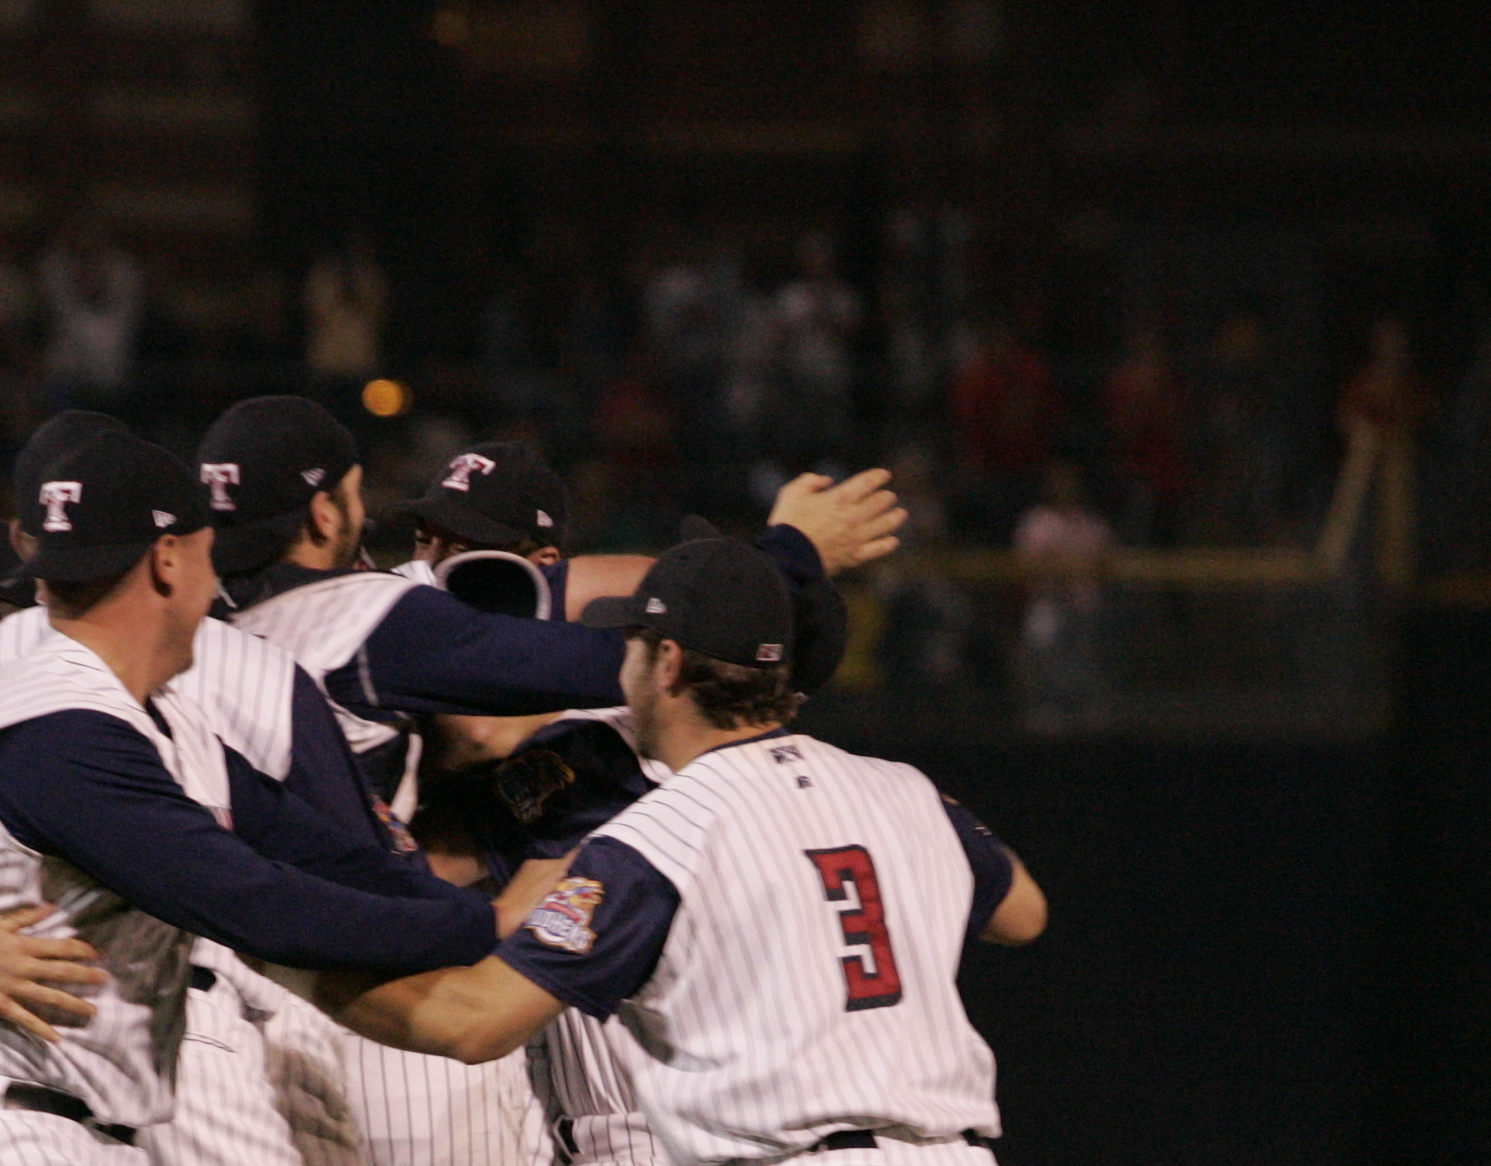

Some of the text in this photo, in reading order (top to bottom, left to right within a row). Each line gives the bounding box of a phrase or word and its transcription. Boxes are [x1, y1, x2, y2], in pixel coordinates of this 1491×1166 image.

[200, 463, 241, 511] T
[442, 452, 496, 492] T
[39, 480, 83, 532] T
[803, 843, 903, 1012] 3
